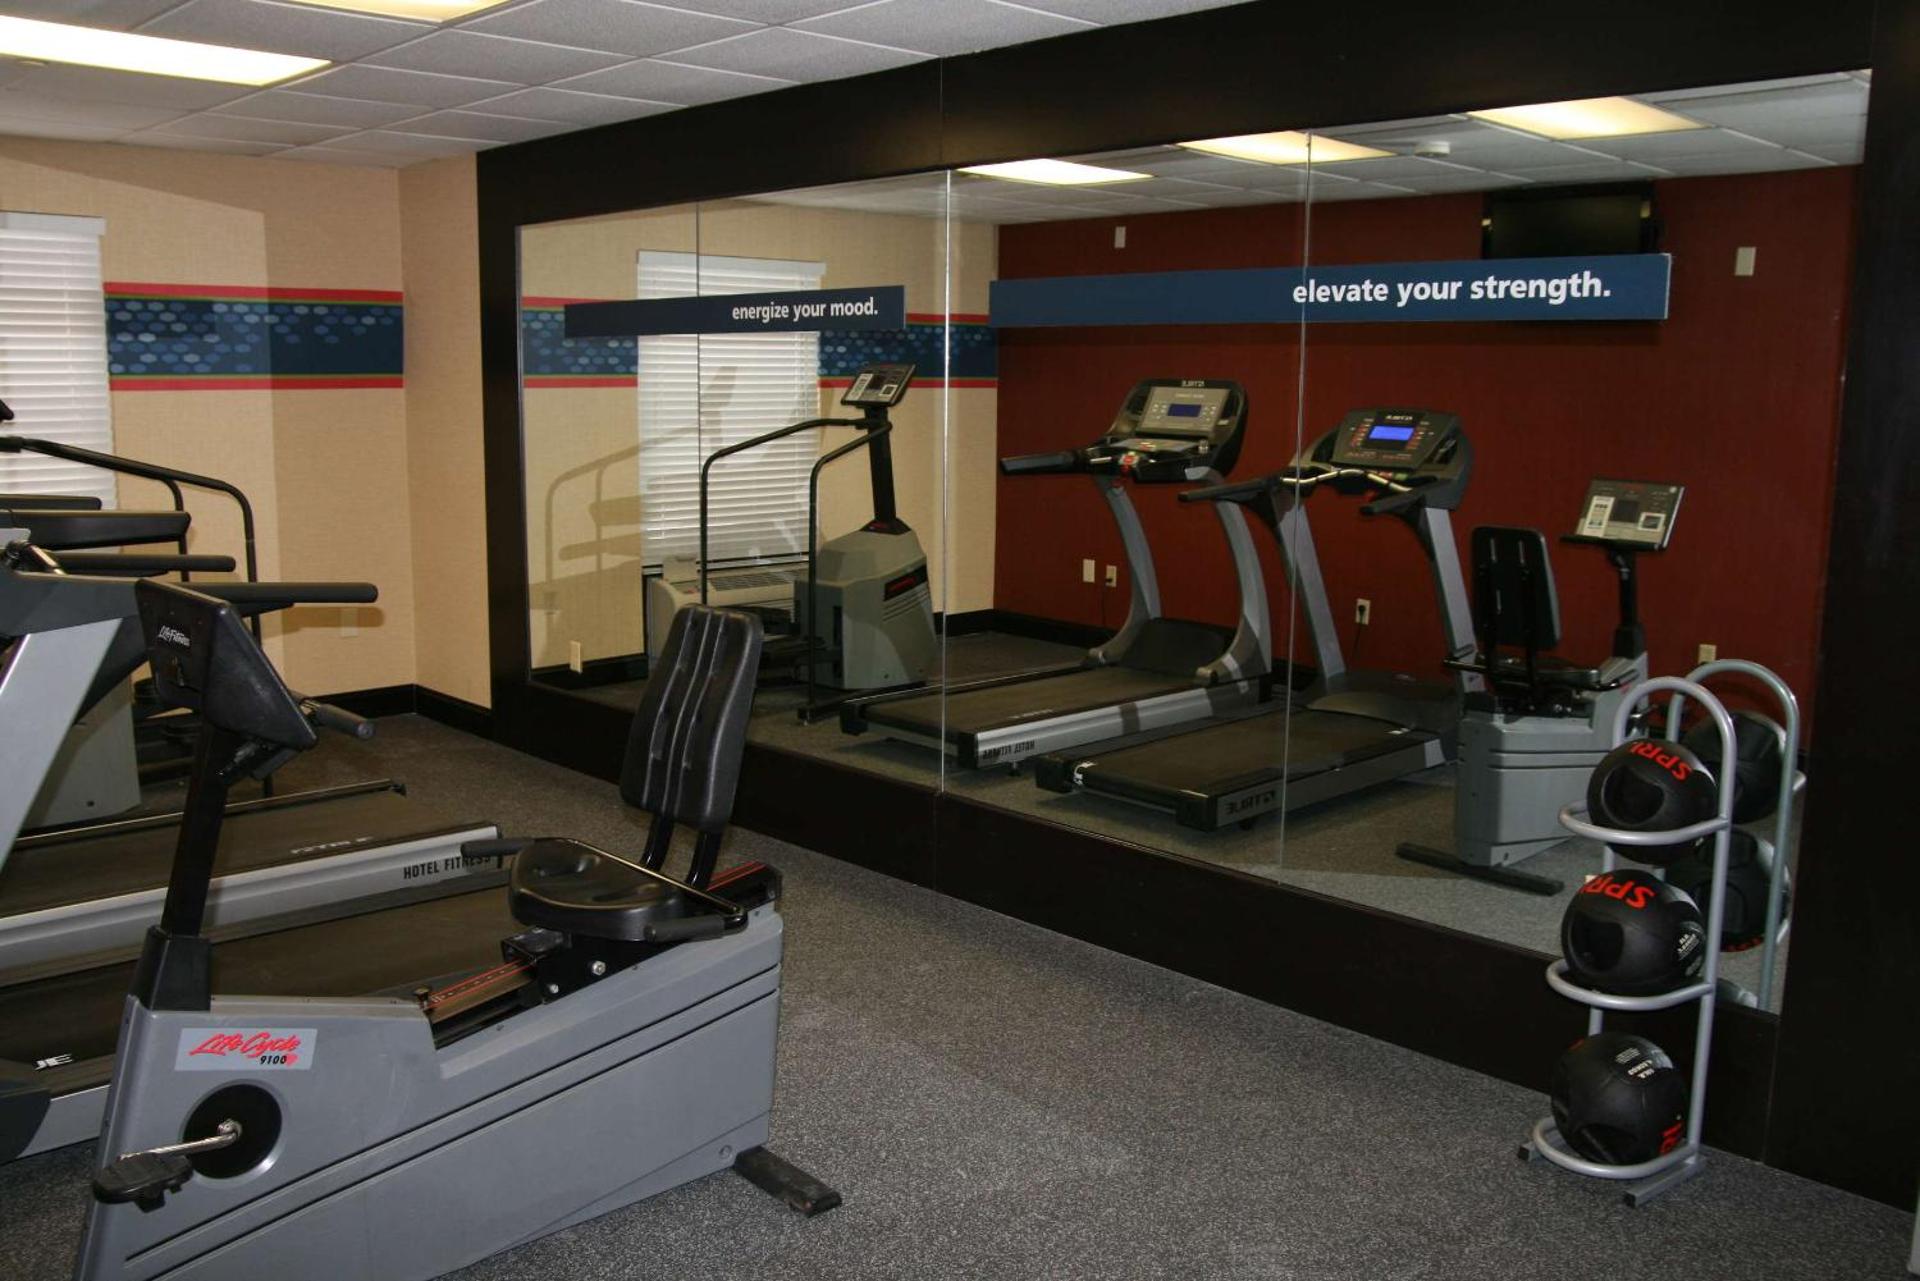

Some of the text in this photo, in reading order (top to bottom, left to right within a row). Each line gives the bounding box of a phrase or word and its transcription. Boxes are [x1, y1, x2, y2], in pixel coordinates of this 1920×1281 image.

[1293, 270, 1611, 307] elevate your strength.
[732, 296, 879, 323] energize your mood.
[403, 861, 440, 879] HOTEL
[259, 1054, 288, 1065] 9100
